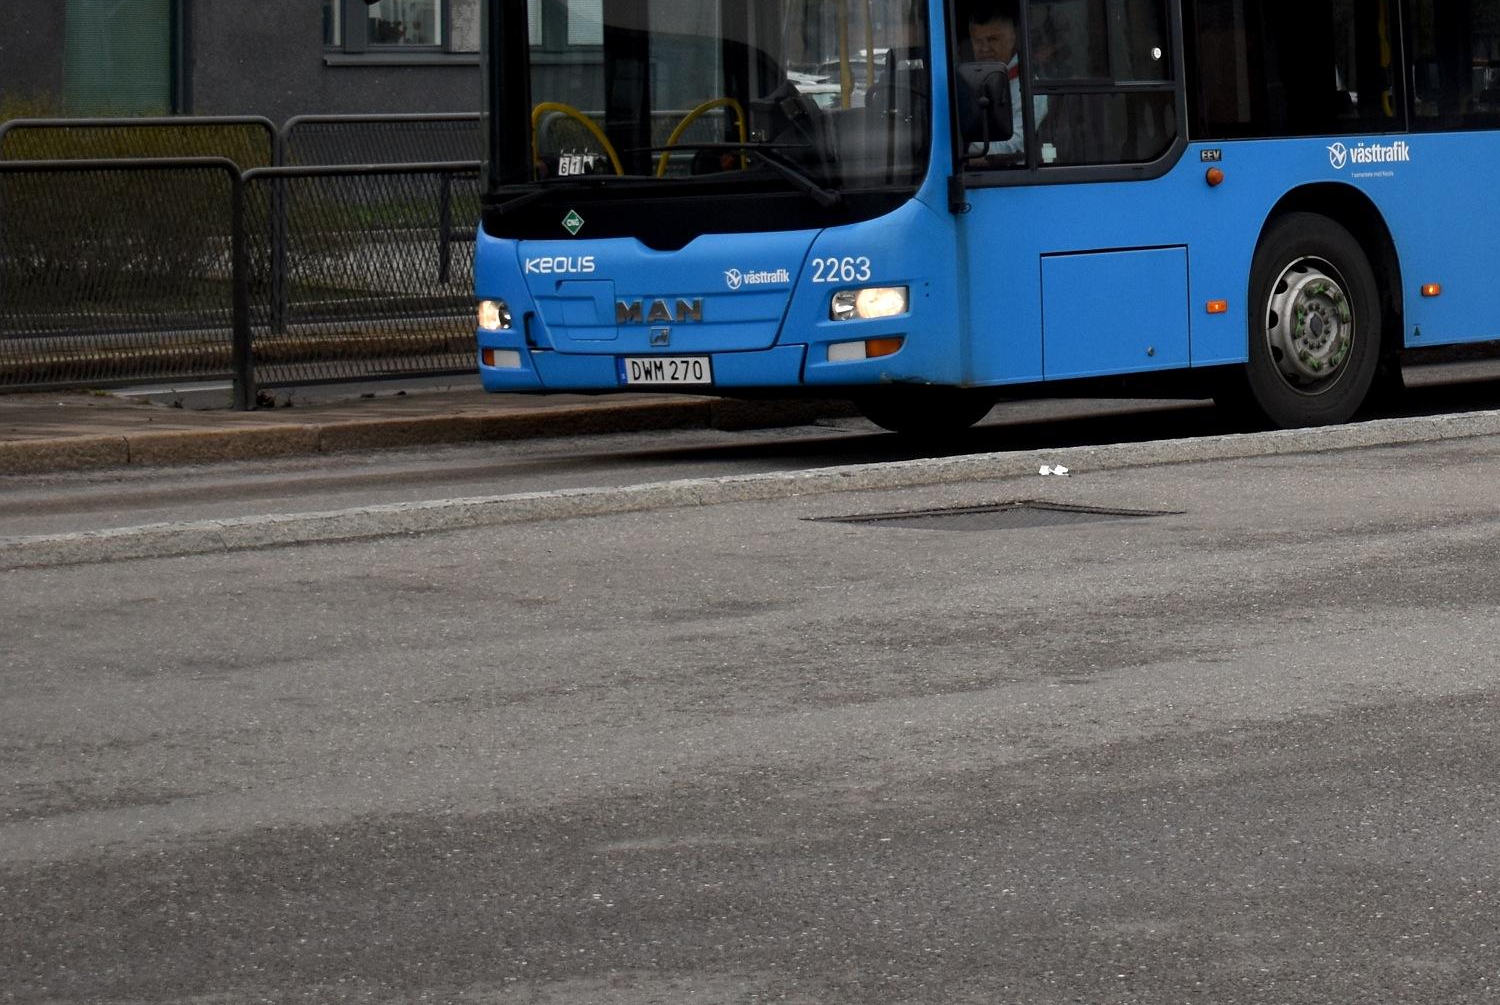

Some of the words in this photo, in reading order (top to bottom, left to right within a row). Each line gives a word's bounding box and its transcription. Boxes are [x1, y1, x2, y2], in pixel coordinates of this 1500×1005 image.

[1201, 150, 1221, 161] EEV
[1349, 140, 1410, 164] västtrafik
[743, 268, 790, 285] västtrafik
[812, 256, 872, 283] 2263
[616, 297, 704, 324] MAN
[632, 359, 665, 383] DWM
[669, 360, 704, 381] 270
